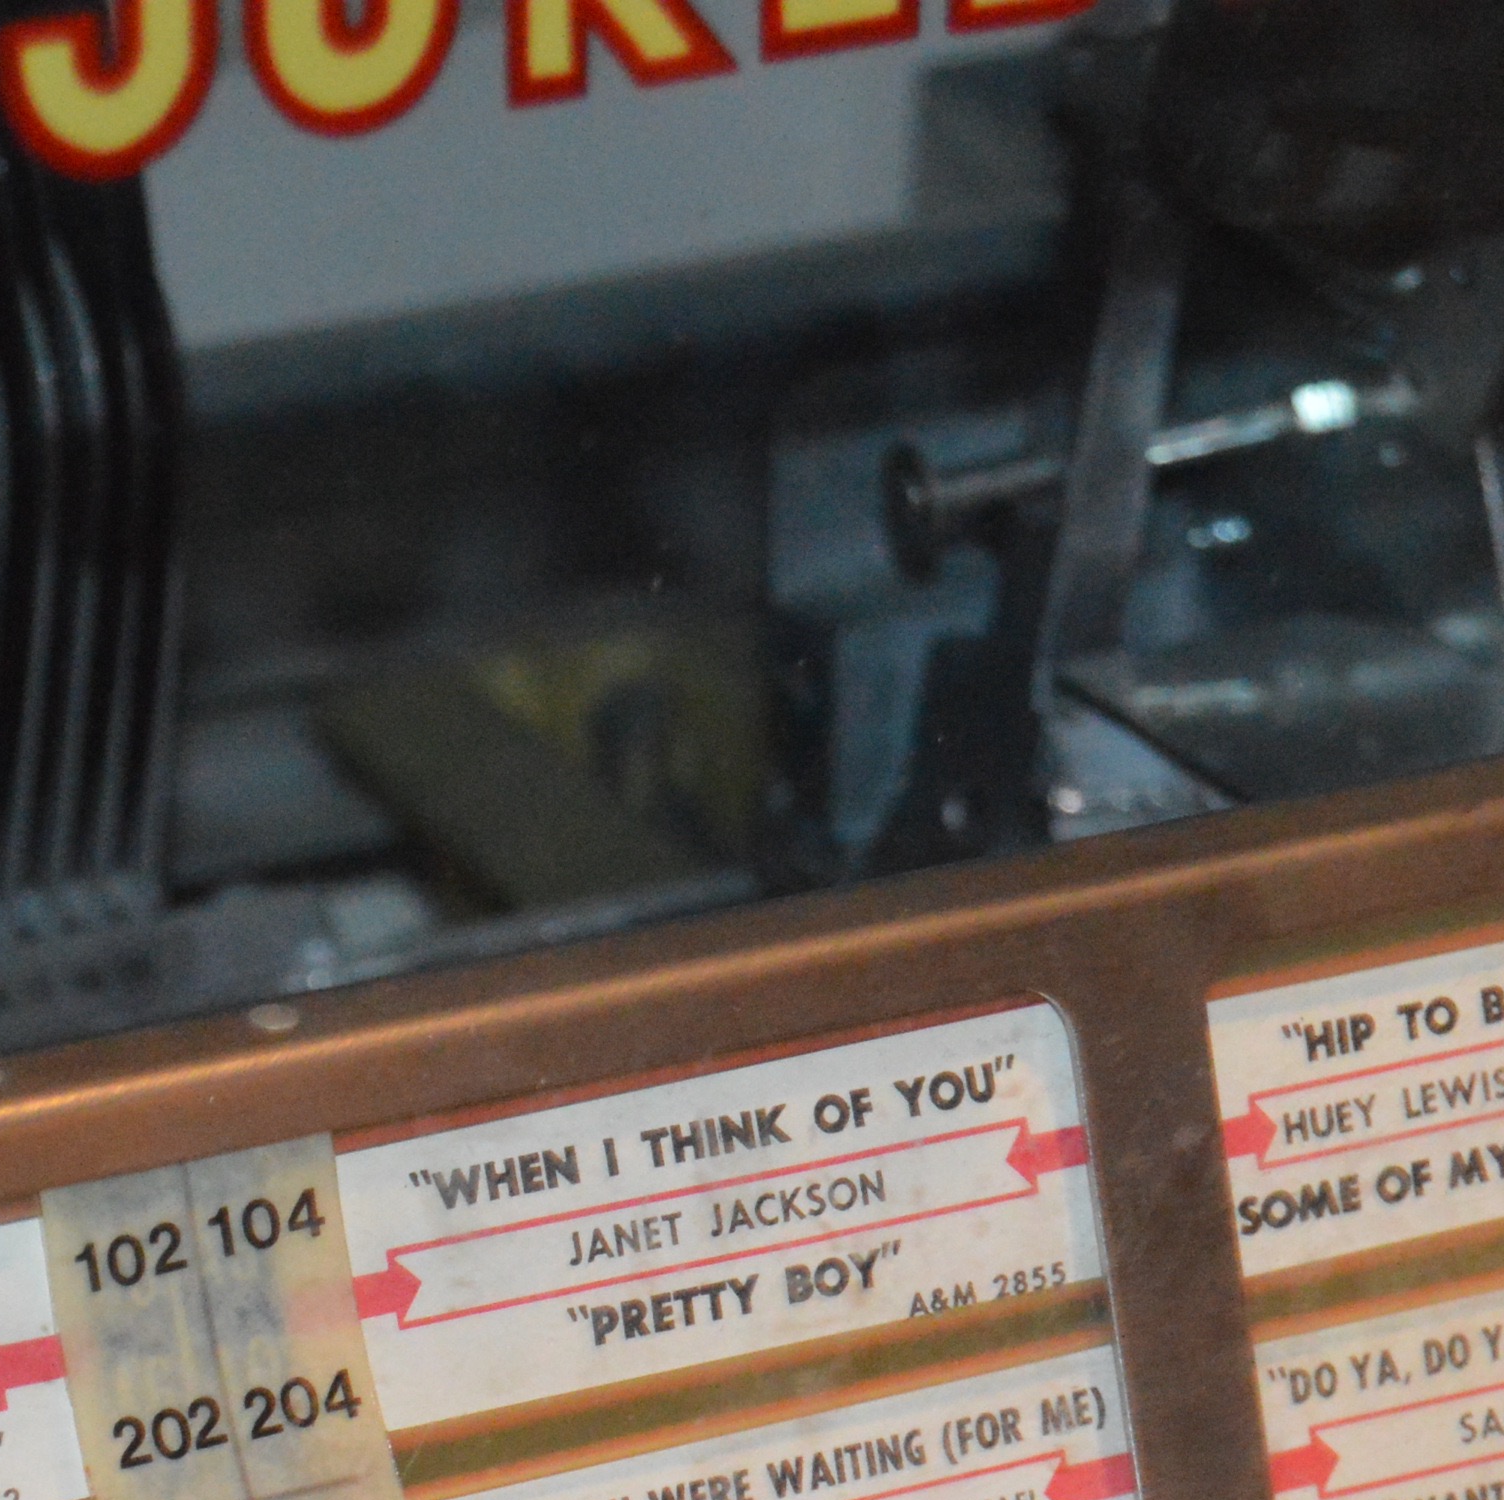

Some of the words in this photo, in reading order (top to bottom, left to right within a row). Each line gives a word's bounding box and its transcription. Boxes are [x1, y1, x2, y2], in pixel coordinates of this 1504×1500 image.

[1282, 1013, 1375, 1064] "HIP
[1398, 996, 1459, 1043] TO
[409, 1144, 580, 1212] "WHEN
[604, 1138, 620, 1178] I
[640, 1103, 787, 1169] THINK
[813, 1087, 875, 1135] OF
[893, 1054, 1015, 1119] YOU"
[1282, 1094, 1376, 1146] HUEY
[74, 1221, 186, 1292] 102
[209, 1188, 326, 1258] 104
[568, 1212, 683, 1267] JANET
[710, 1170, 886, 1238] JACKSON
[1238, 1176, 1361, 1236] SOME
[1376, 1157, 1432, 1204] OF
[567, 1274, 759, 1347] "PRETTY
[787, 1239, 902, 1306] BOY"
[908, 1281, 978, 1319] A&M
[993, 1261, 1069, 1301] 2855
[1267, 1361, 1339, 1407] "DO
[1349, 1344, 1413, 1391] YA,
[1422, 1332, 1471, 1377] DO
[113, 1397, 229, 1469] 202
[244, 1368, 361, 1440] 204
[767, 1428, 927, 1500] WAITING
[942, 1402, 1023, 1466] (FOR
[1040, 1386, 1107, 1437] ME)
